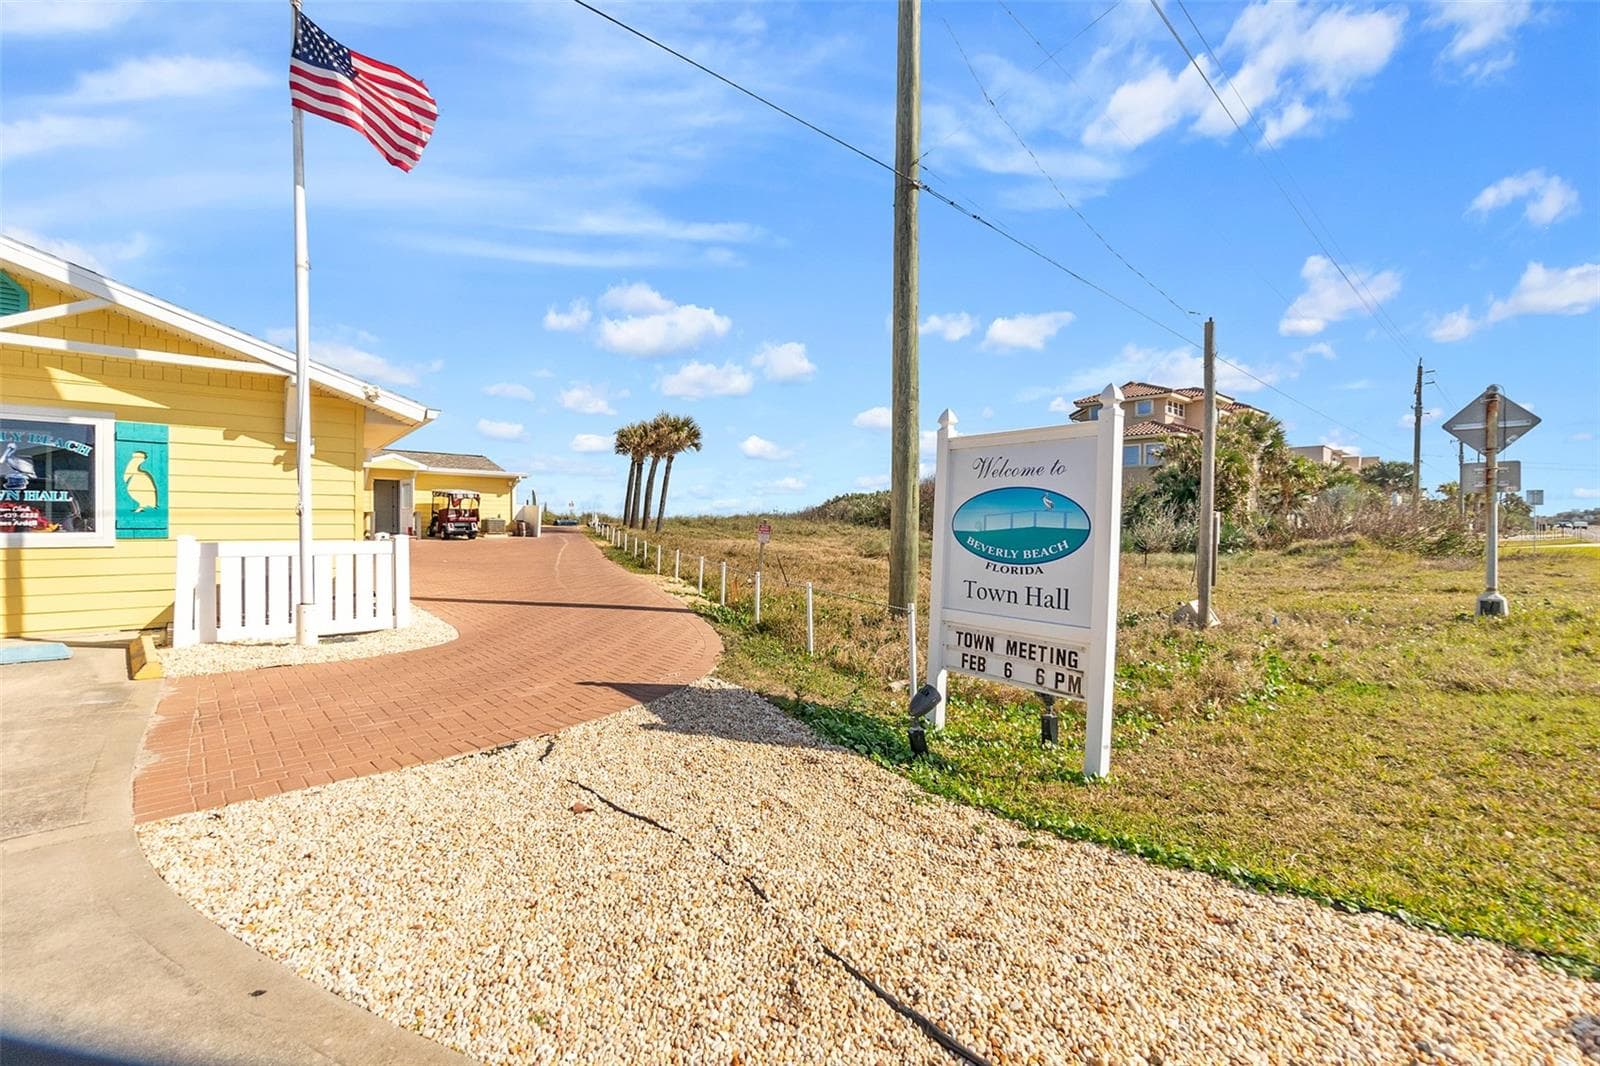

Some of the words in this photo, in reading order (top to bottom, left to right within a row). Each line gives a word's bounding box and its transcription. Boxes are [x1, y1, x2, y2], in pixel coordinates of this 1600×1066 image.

[28, 432, 93, 456] BEACH
[972, 456, 1045, 479] Welcome
[1050, 459, 1066, 475] to
[23, 490, 73, 502] HALL
[966, 536, 1019, 559] BEVERLY
[1023, 539, 1069, 559] BEACH
[985, 562, 1044, 575] FLORIDA
[963, 579, 1019, 605] Town
[1024, 586, 1071, 611] Hall
[956, 631, 994, 653] TOWN
[1006, 639, 1078, 669] MEETING
[961, 653, 986, 673] FEB
[1004, 662, 1013, 679] 6
[1036, 668, 1045, 685] 6
[1054, 672, 1082, 694] PM
